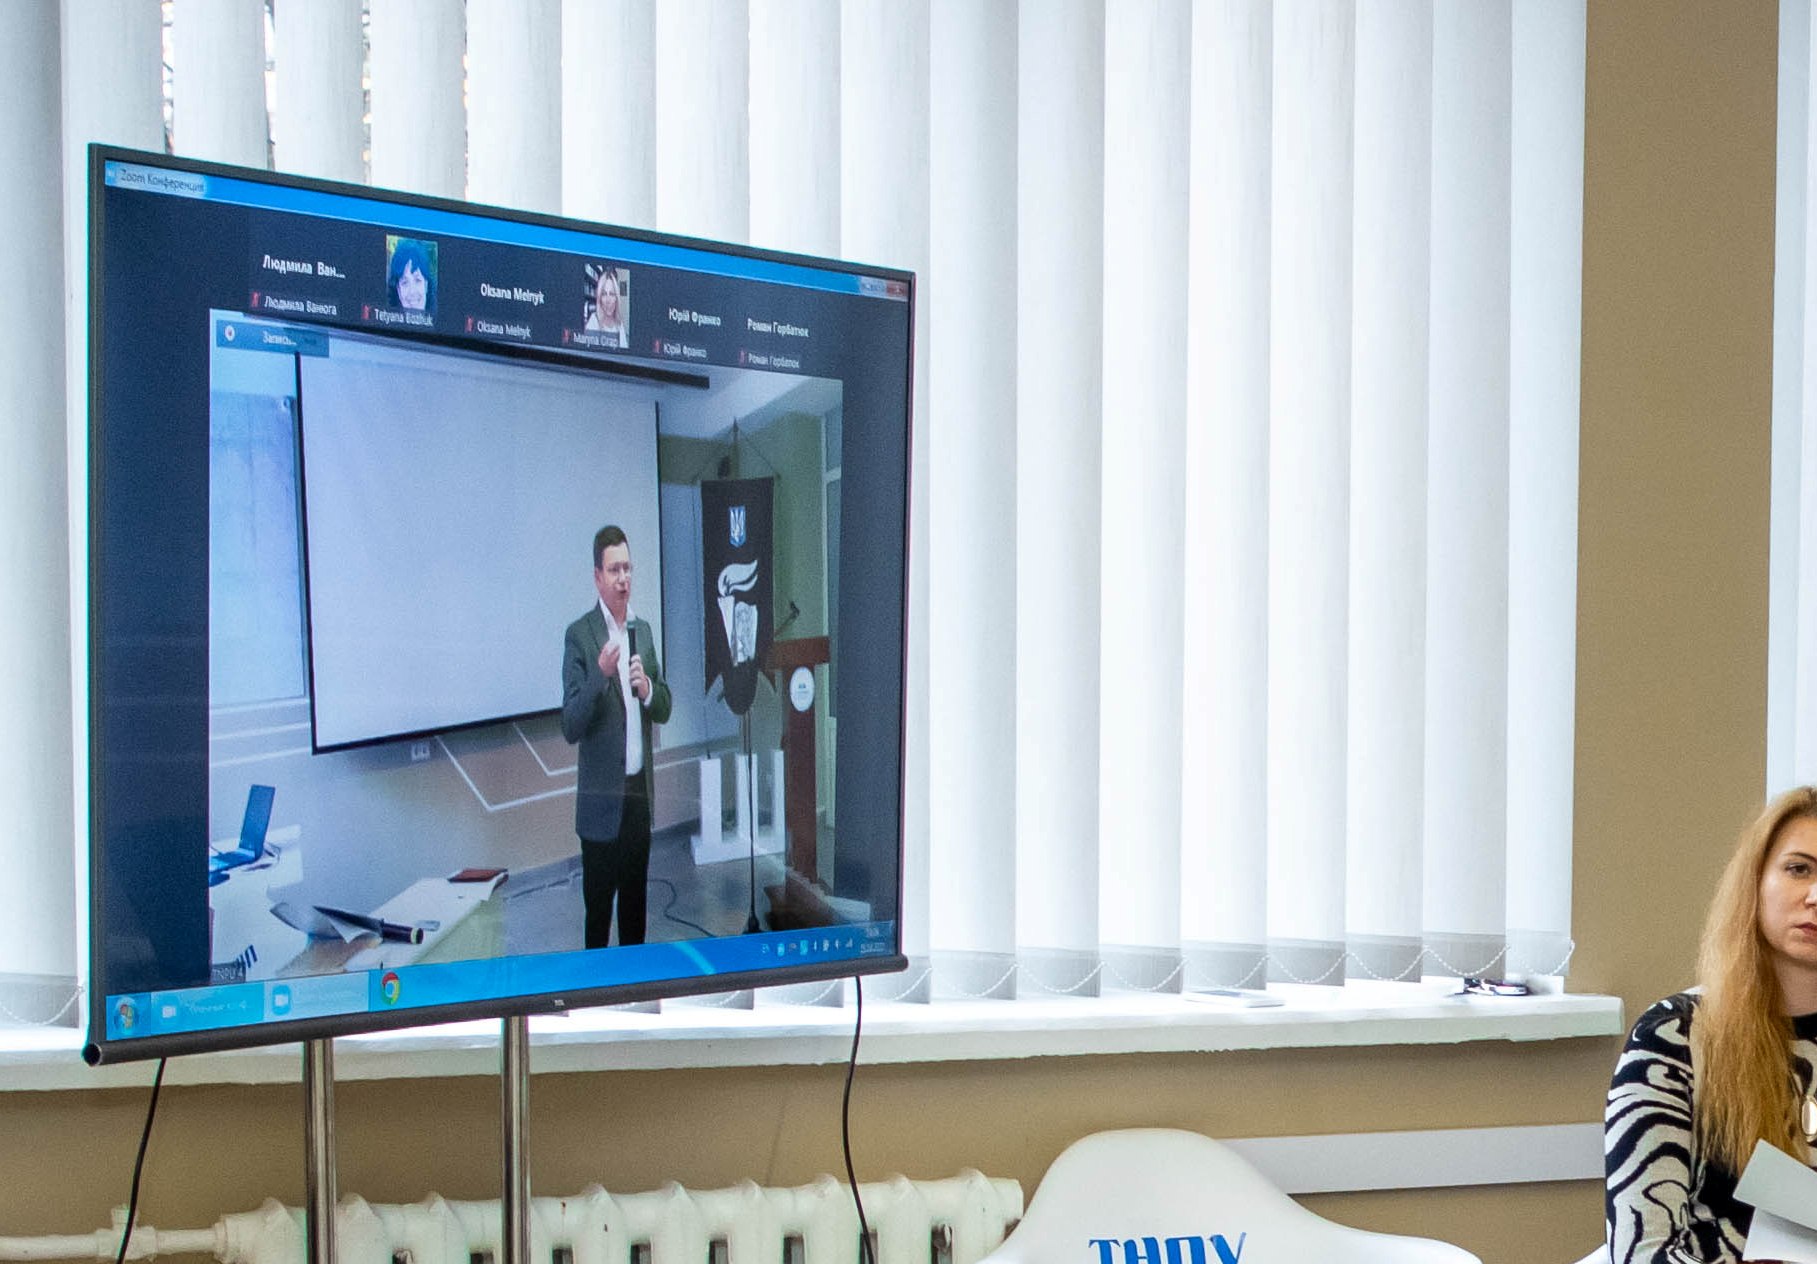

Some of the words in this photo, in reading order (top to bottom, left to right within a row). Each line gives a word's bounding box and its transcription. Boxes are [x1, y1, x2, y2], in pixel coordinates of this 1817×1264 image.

[120, 168, 146, 185] Zoom
[262, 254, 313, 276] Людмила
[480, 282, 512, 301] Oksana
[513, 287, 545, 307] Melnyk
[747, 317, 772, 333] Роман
